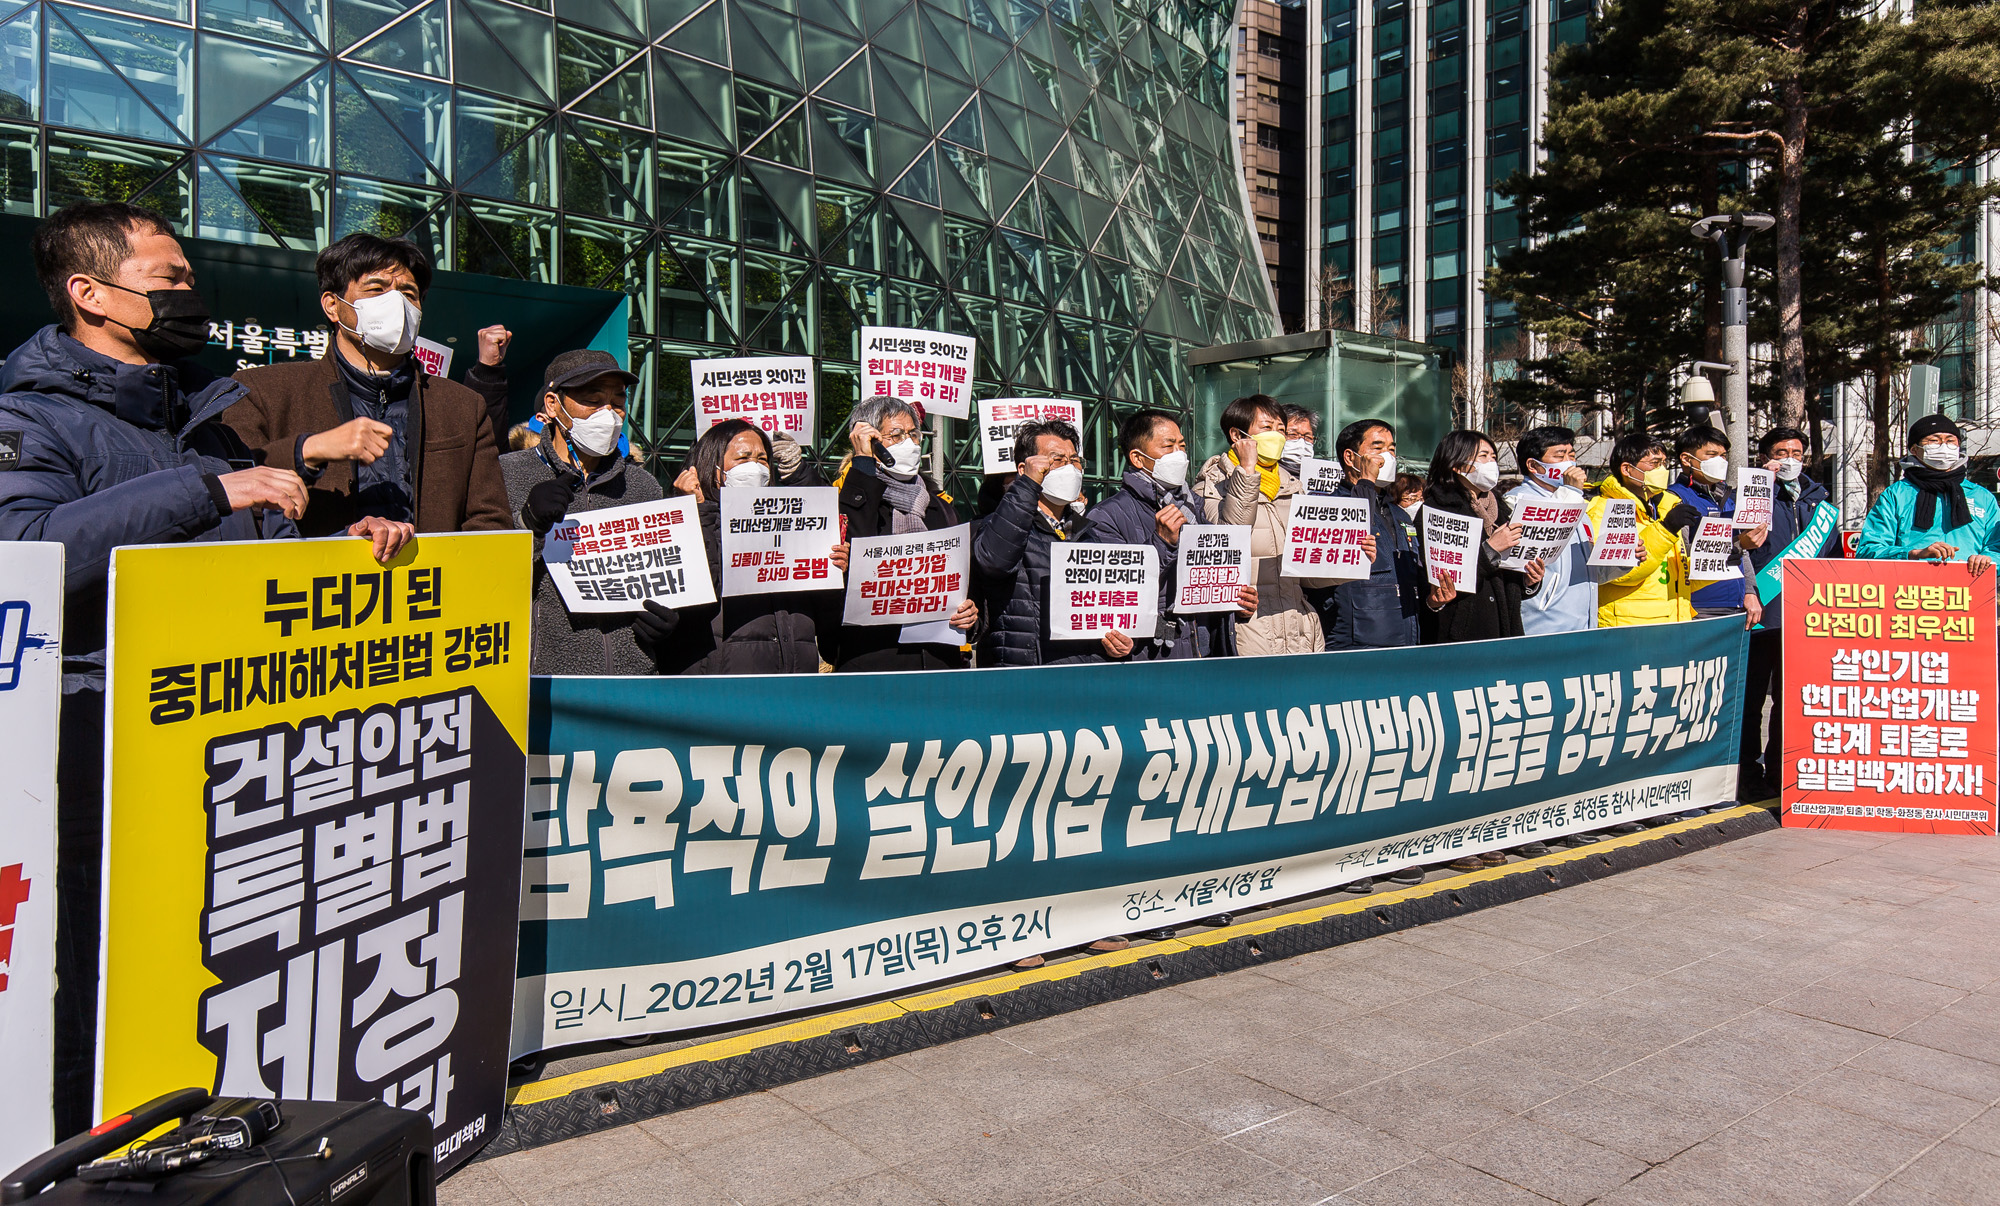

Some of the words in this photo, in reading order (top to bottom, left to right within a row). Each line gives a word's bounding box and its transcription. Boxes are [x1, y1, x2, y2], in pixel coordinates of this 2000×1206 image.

[869, 337, 926, 354] 시민생명
[929, 342, 968, 361] 앗아간
[700, 369, 763, 388] 시민생명
[767, 368, 806, 385] 앗아간
[868, 359, 966, 384] 현대산업개발
[701, 391, 808, 414] 현대산업개발
[992, 404, 1040, 421] 돈보다
[1548, 467, 1561, 480] 12
[753, 497, 803, 515] 살인기업
[1295, 506, 1338, 521] 시민생명
[1341, 508, 1366, 522] 앗아간
[1522, 506, 1560, 523] 돈보다
[554, 525, 594, 541] 시민의
[598, 517, 640, 536] 생명과
[643, 509, 685, 529] 안전을
[729, 517, 793, 533] 현대산업개발
[795, 517, 828, 531] 봐주기
[1446, 517, 1469, 533] 생명과
[572, 536, 627, 556] 탐욕으로
[631, 529, 672, 548] 짓밟은
[863, 545, 902, 558] 서울시에
[905, 543, 924, 555] 강력
[926, 537, 961, 553] 촉구한다!
[1198, 533, 1229, 548] 살인기업
[567, 545, 682, 577] 현대산업개발
[731, 552, 762, 568] 되풀이
[764, 551, 785, 565] 되는
[877, 554, 946, 578] 살인기업
[1067, 549, 1106, 565] 시민의
[1107, 550, 1144, 566] 생명과
[1186, 549, 1242, 566] 현대산업개발
[757, 567, 789, 583] 참사의
[792, 558, 828, 580] 공범
[1065, 568, 1102, 584] 안전이
[1105, 569, 1145, 584] 먼저다!
[1190, 567, 1240, 586] 엄정처벌과
[1658, 561, 1670, 584] 3
[575, 569, 685, 601] 퇴출하라!
[861, 573, 961, 598] 현대산업개발
[1181, 586, 1210, 605] 퇴출이
[264, 570, 393, 638] 누더기
[407, 567, 442, 622] 된
[871, 595, 948, 616] 퇴출하라!
[1071, 590, 1096, 607] 현산
[1098, 590, 1138, 607] 퇴출로
[1808, 583, 1885, 609] 시민의
[1894, 584, 1972, 612] 생명과
[1805, 612, 1882, 639] 안전이
[1890, 614, 1975, 642] 최우선!
[149, 631, 433, 725] 중대재해처벌법
[444, 621, 510, 674] 강화!
[1831, 648, 1949, 684] 살인기업
[1801, 684, 1980, 722] 현대산업개발
[1812, 722, 1872, 755] 업계
[1879, 724, 1969, 758] 퇴출로
[212, 694, 472, 838] 건설안전
[1796, 758, 1983, 796] 일벌백계하자!
[519, 745, 846, 921] 탐욕적인
[859, 725, 1123, 880] 살인기업
[1126, 691, 1445, 847] 현대산업개발의
[1449, 679, 1554, 794] 퇴출을
[1558, 671, 1621, 776] 강력
[1622, 656, 1728, 760] 촉구한다!
[1468, 816, 1512, 843] 퇴출을
[1515, 809, 1541, 836] 위한
[1541, 803, 1570, 828] 학동,
[1572, 795, 1608, 822] 화정동
[1611, 791, 1636, 815] 참사
[1636, 779, 1693, 807] 시민대책위
[1792, 803, 1844, 816] 현대산업개발
[1846, 806, 1863, 816] 퇴출
[1865, 807, 1874, 817] 및
[1925, 809, 1942, 820] 참사
[1944, 810, 1988, 821] 시민대책위
[208, 780, 471, 956] 특별법
[1260, 865, 1283, 891] 앞
[783, 948, 834, 994] 2월
[842, 925, 950, 979] 17일(목)
[956, 914, 1003, 955] 오후
[1011, 906, 1053, 948] 2시
[205, 890, 465, 1101] 제정
[332, 1167, 366, 1197] KANALS
